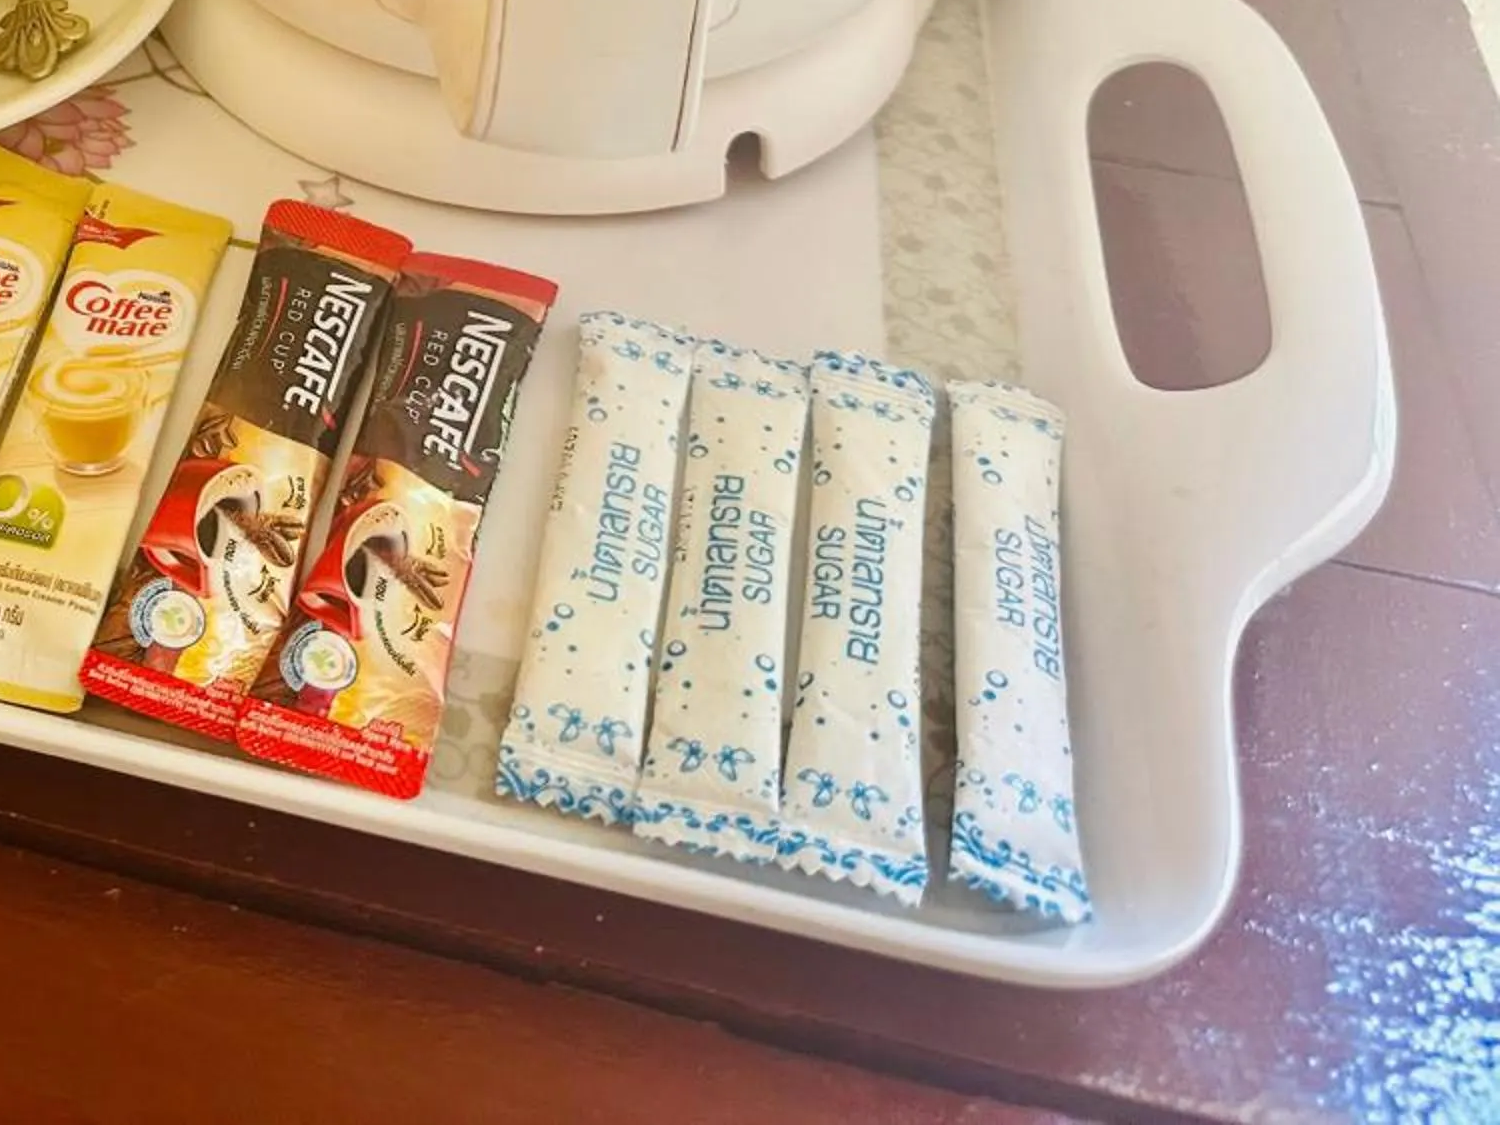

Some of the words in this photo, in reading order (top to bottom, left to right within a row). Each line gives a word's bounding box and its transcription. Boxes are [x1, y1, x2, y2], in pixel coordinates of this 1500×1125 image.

[66, 280, 173, 320] Coffee
[86, 316, 168, 337] mate
[287, 286, 313, 322] RED
[423, 329, 449, 366] RED
[271, 331, 296, 373] CUP
[405, 375, 432, 423] CUP
[570, 441, 642, 603] น้ำตาลทราย
[631, 482, 668, 582] SUGAR
[679, 474, 745, 631] น้ำตาลทราย
[742, 510, 777, 605] SUGAR
[810, 524, 847, 620] SUGAR
[846, 497, 905, 666] น้ำตาลทราย
[994, 527, 1026, 628] SUGAR
[1024, 514, 1061, 681] นำตาลทราย
